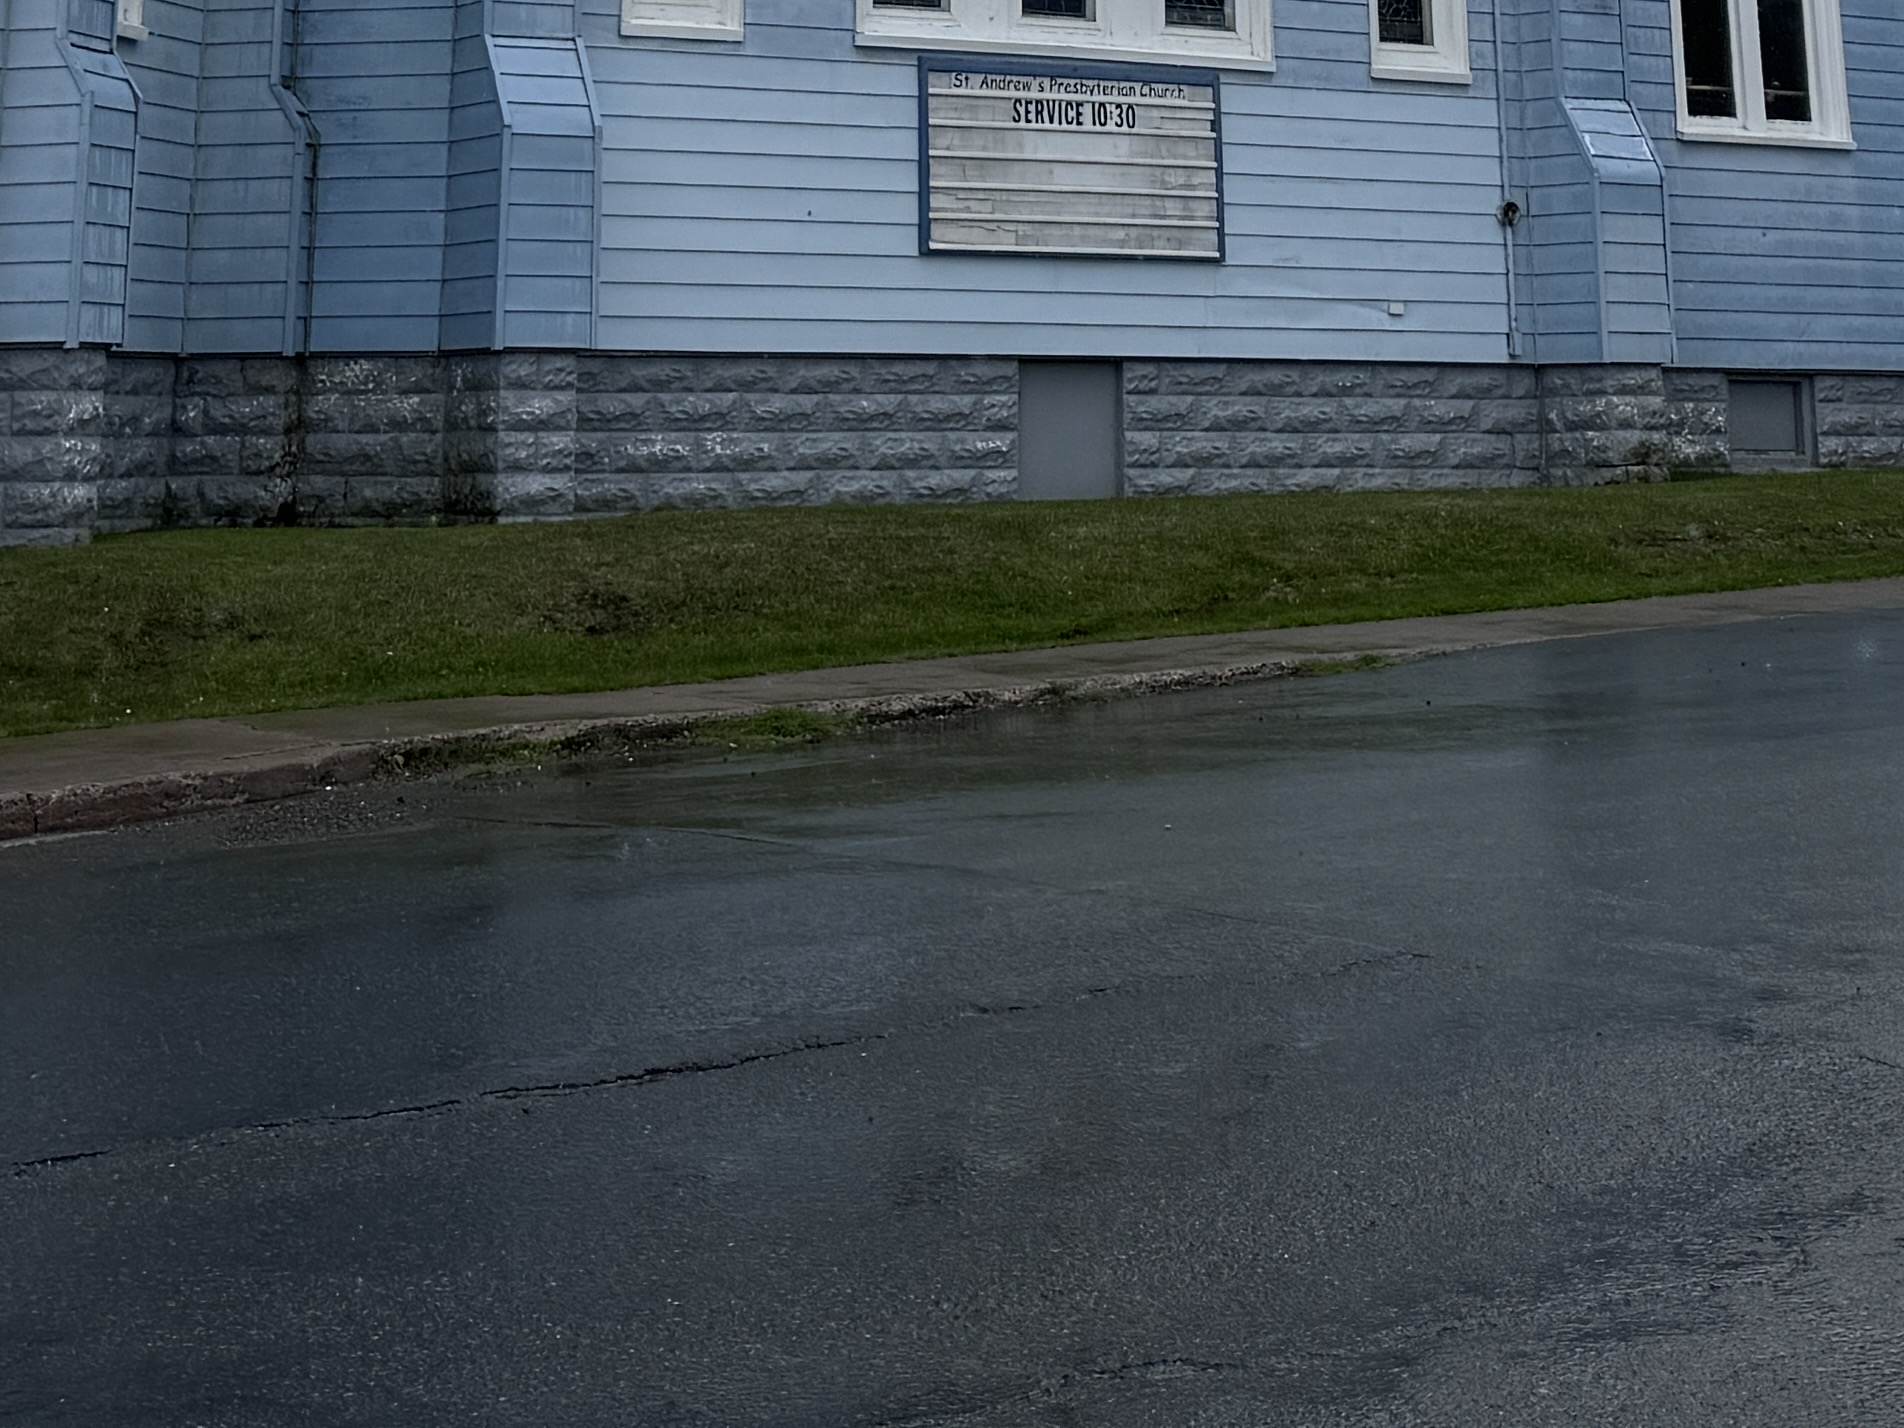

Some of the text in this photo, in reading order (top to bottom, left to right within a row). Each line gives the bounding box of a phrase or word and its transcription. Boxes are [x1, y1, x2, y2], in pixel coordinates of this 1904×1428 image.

[979, 73, 1045, 93] Andrew's
[1049, 75, 1137, 98] Presbyterian
[1139, 81, 1186, 101] Church
[1012, 98, 1136, 129] SERVICE 10:30
